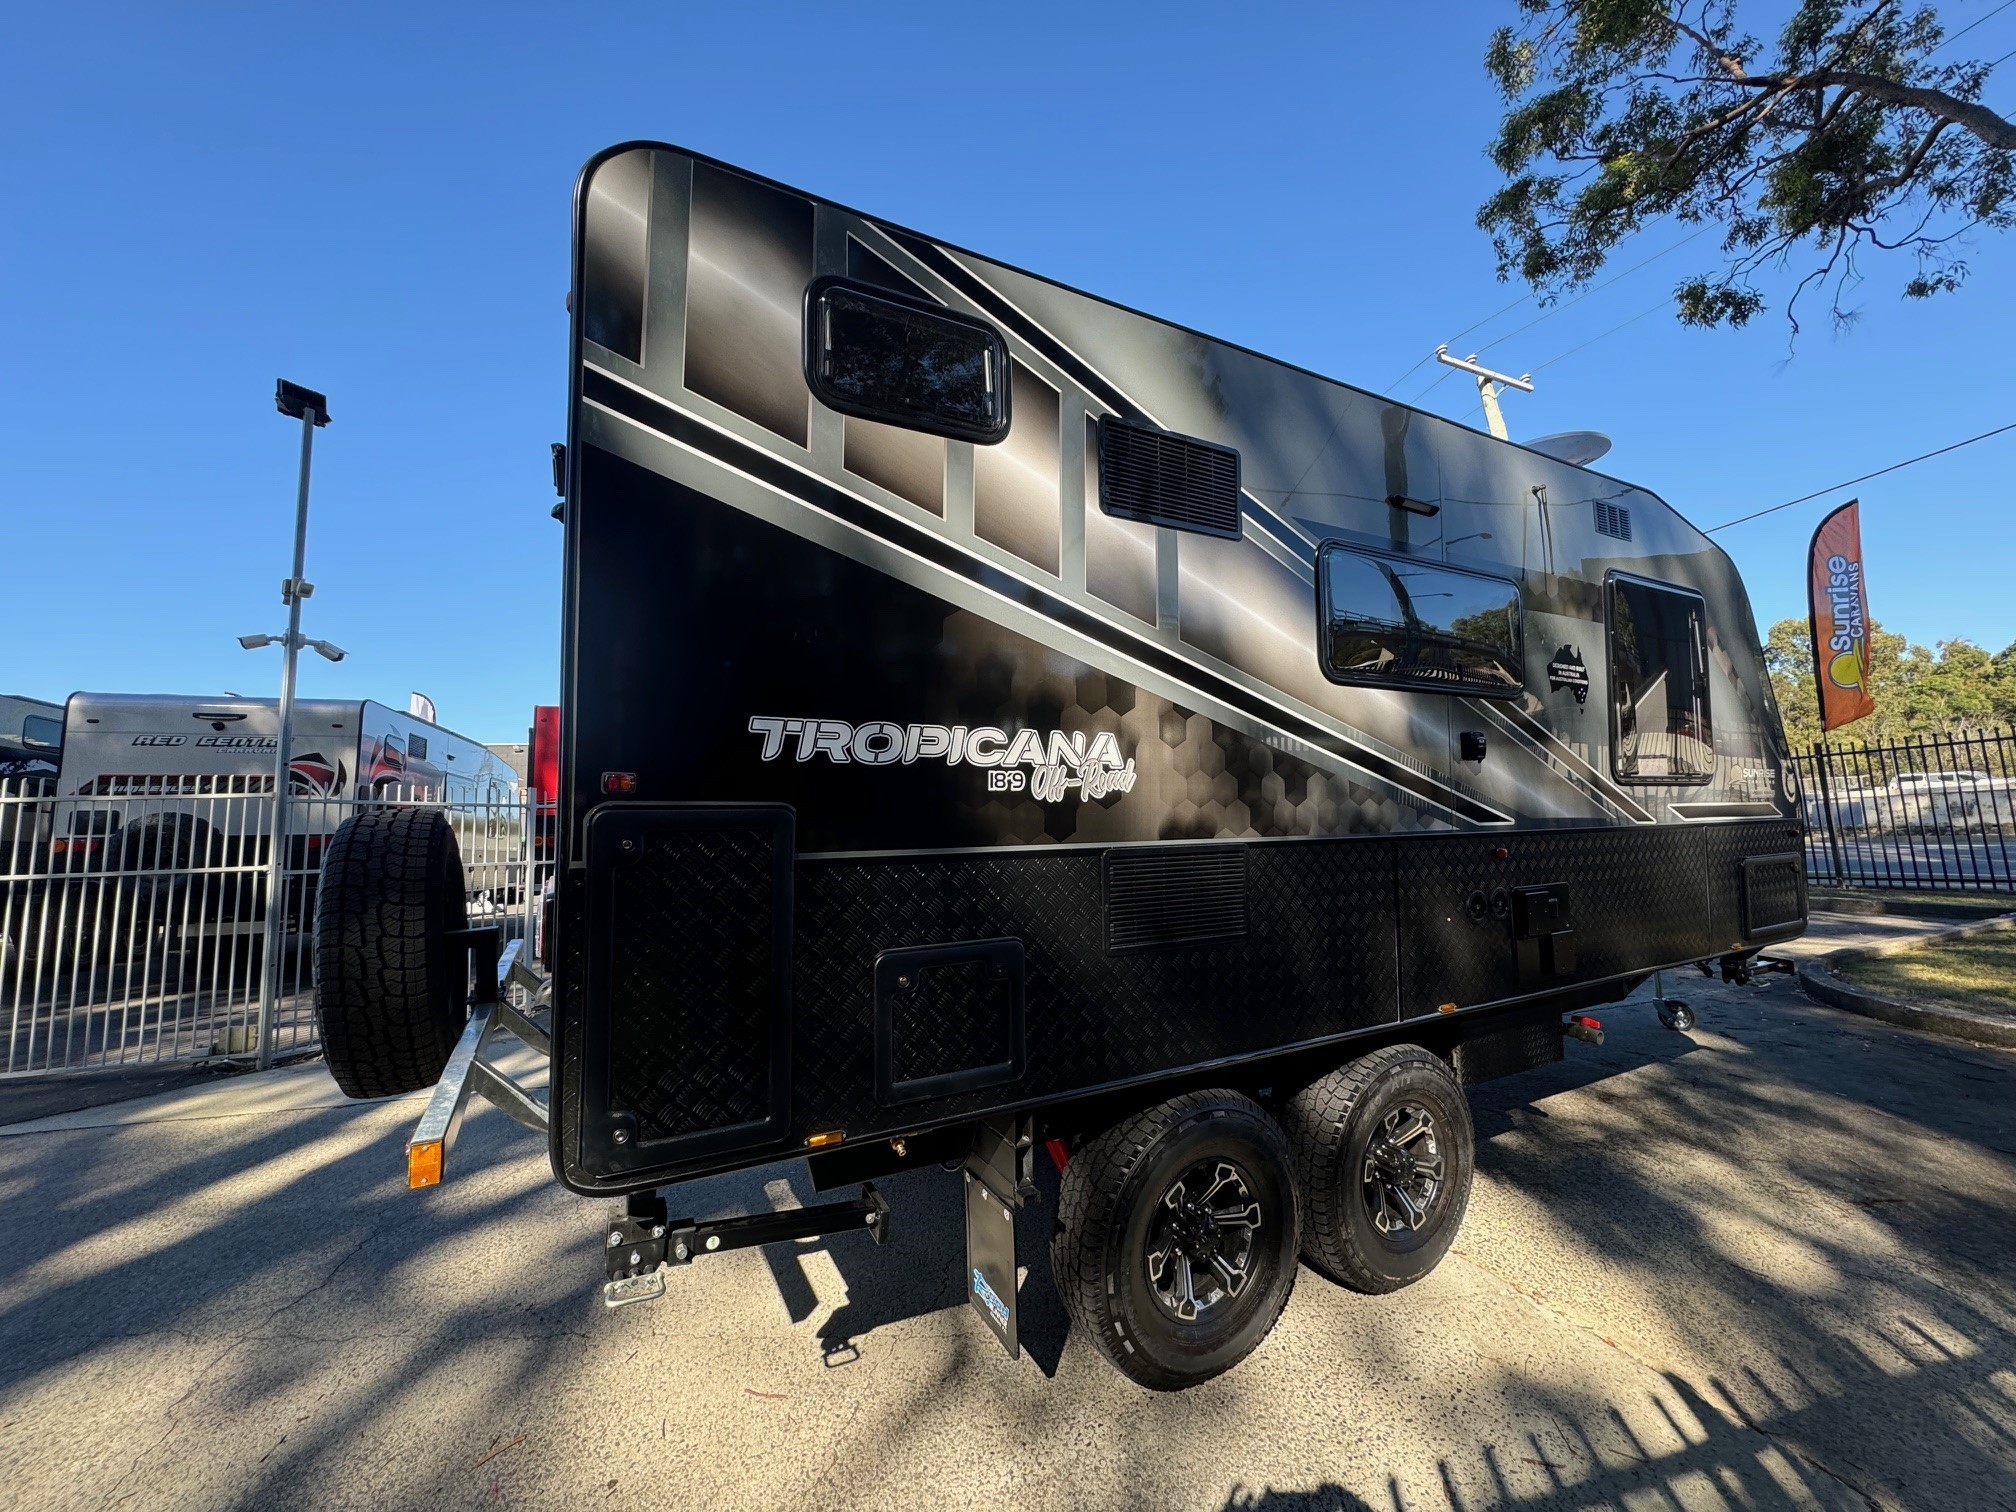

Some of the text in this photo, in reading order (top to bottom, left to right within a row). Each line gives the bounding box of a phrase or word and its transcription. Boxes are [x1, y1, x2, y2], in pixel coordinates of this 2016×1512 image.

[1828, 555, 1850, 651] Sunrise
[1848, 562, 1864, 638] CARAVANS
[132, 735, 294, 748] RED CENTR
[748, 716, 1124, 768] TROPICANA
[1031, 758, 1137, 802] Off-Road
[1743, 768, 1775, 779] SUNRISE
